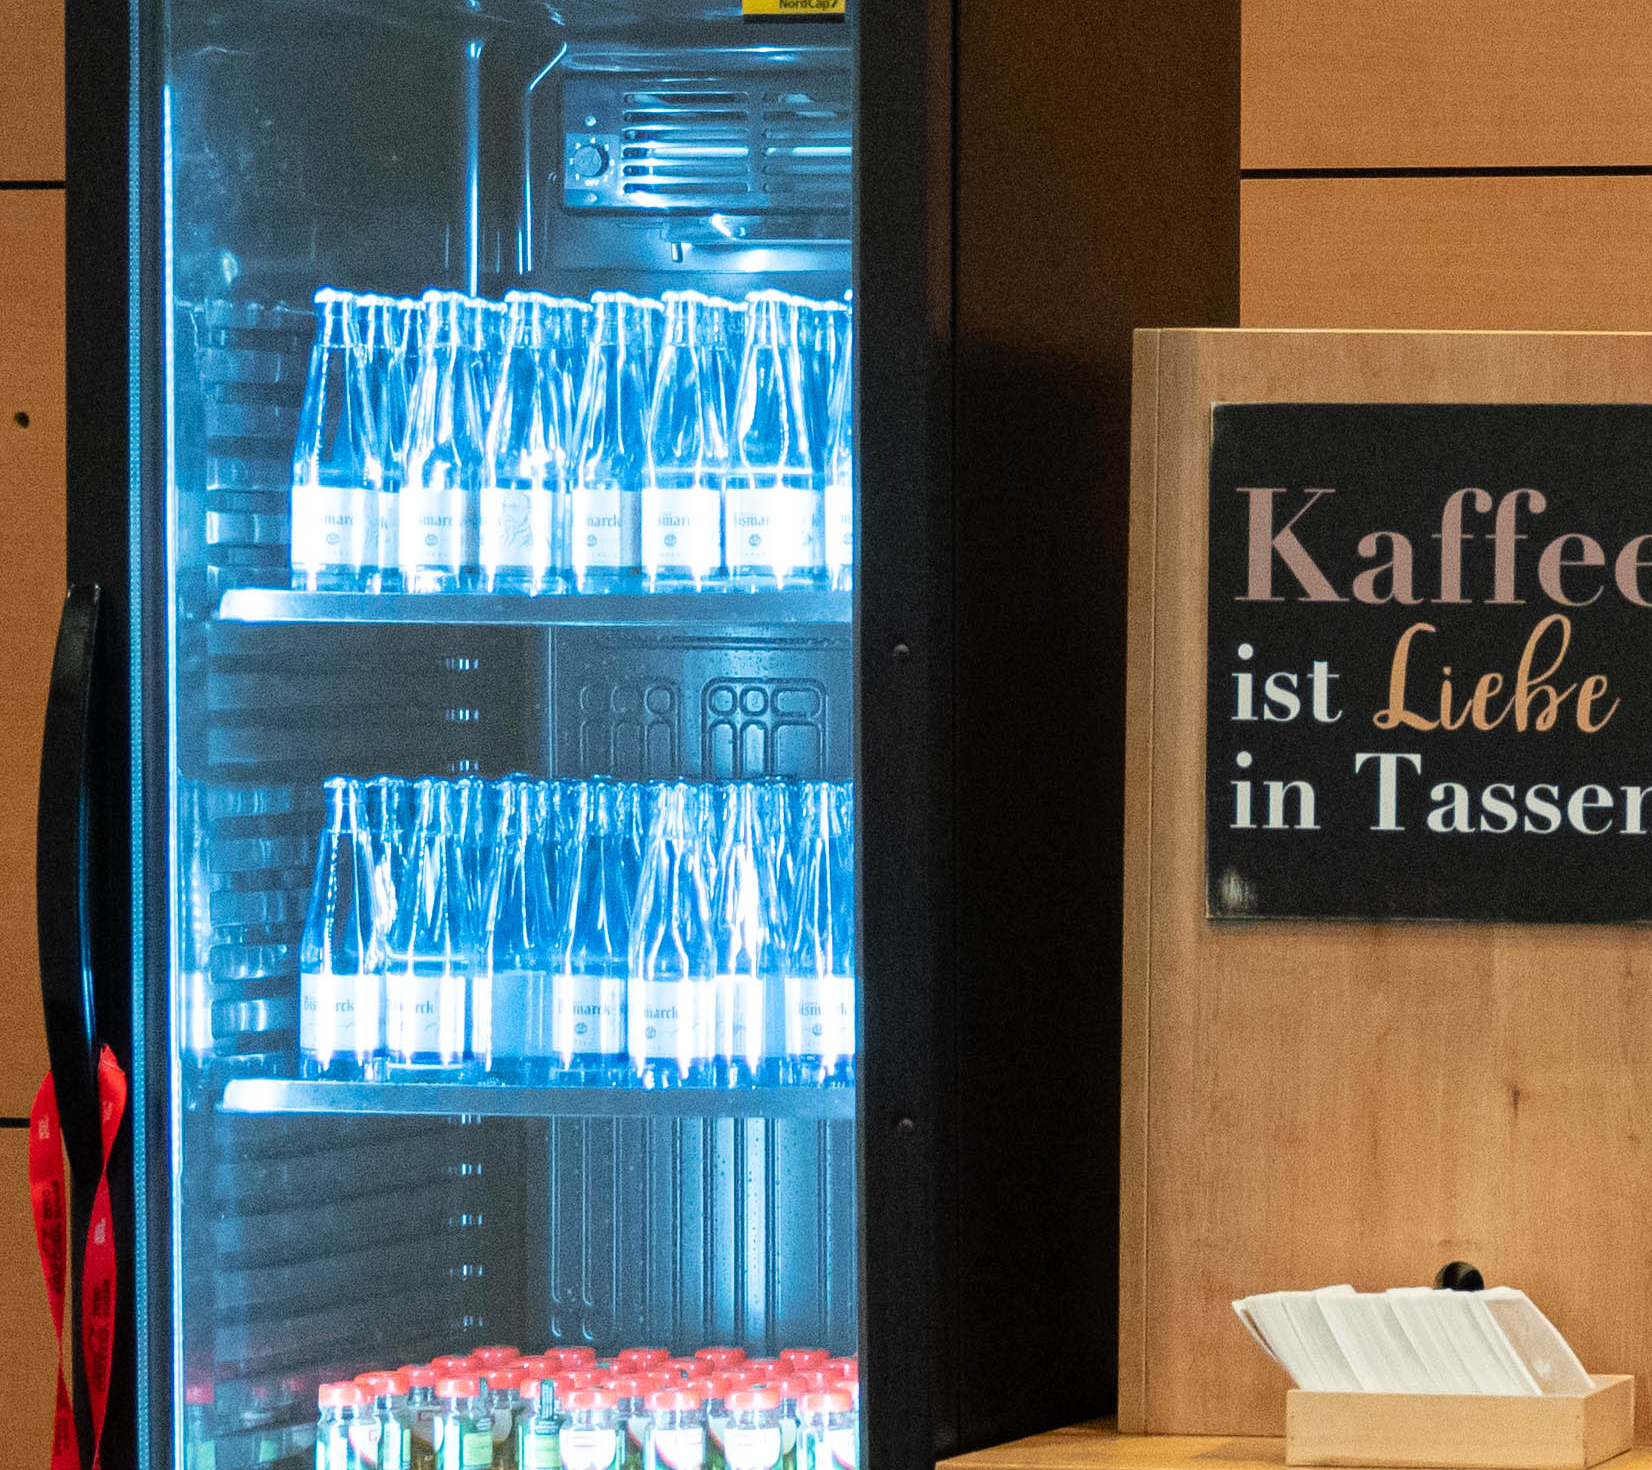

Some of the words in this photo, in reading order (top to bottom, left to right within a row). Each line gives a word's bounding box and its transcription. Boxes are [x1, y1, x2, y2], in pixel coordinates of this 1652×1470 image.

[1230, 642, 1343, 723] ist
[1373, 613, 1621, 733] Liebe
[1229, 750, 1321, 829] in
